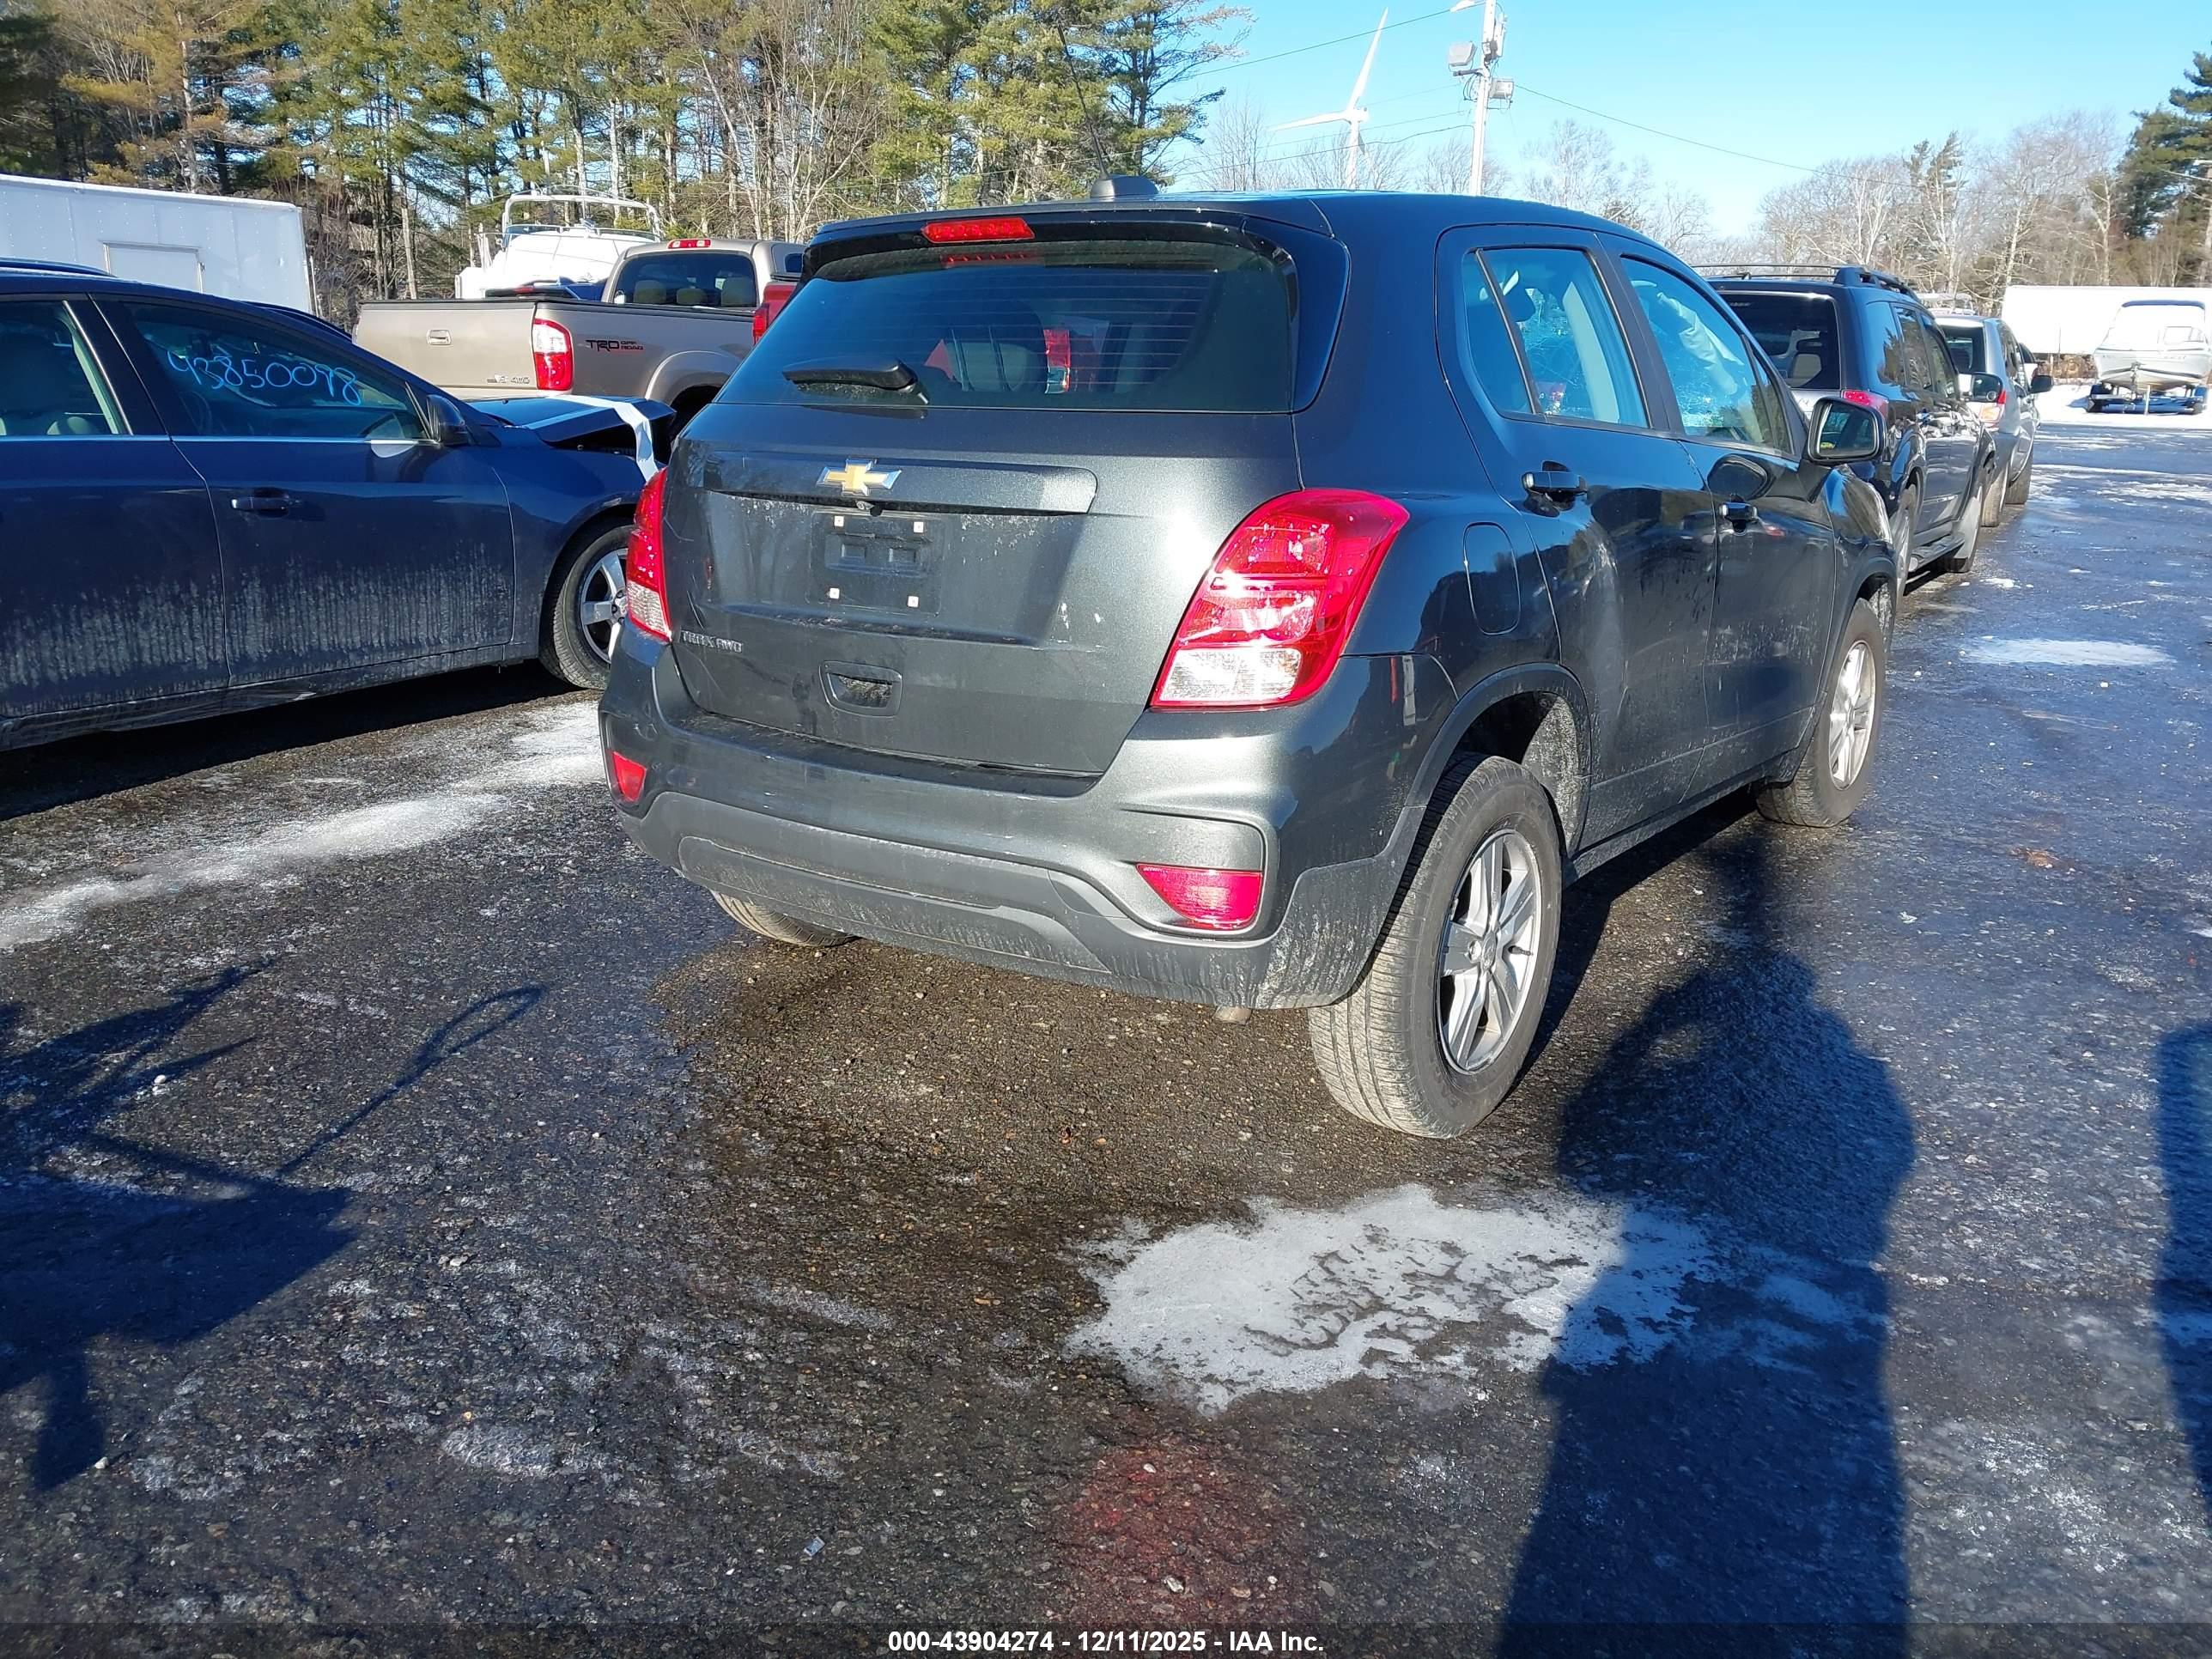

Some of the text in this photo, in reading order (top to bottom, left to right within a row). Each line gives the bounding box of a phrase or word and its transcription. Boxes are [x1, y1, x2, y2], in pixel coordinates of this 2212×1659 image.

[585, 339, 619, 352] TRD
[167, 349, 362, 406] 43850098
[680, 629, 744, 653] TRAX AWD
